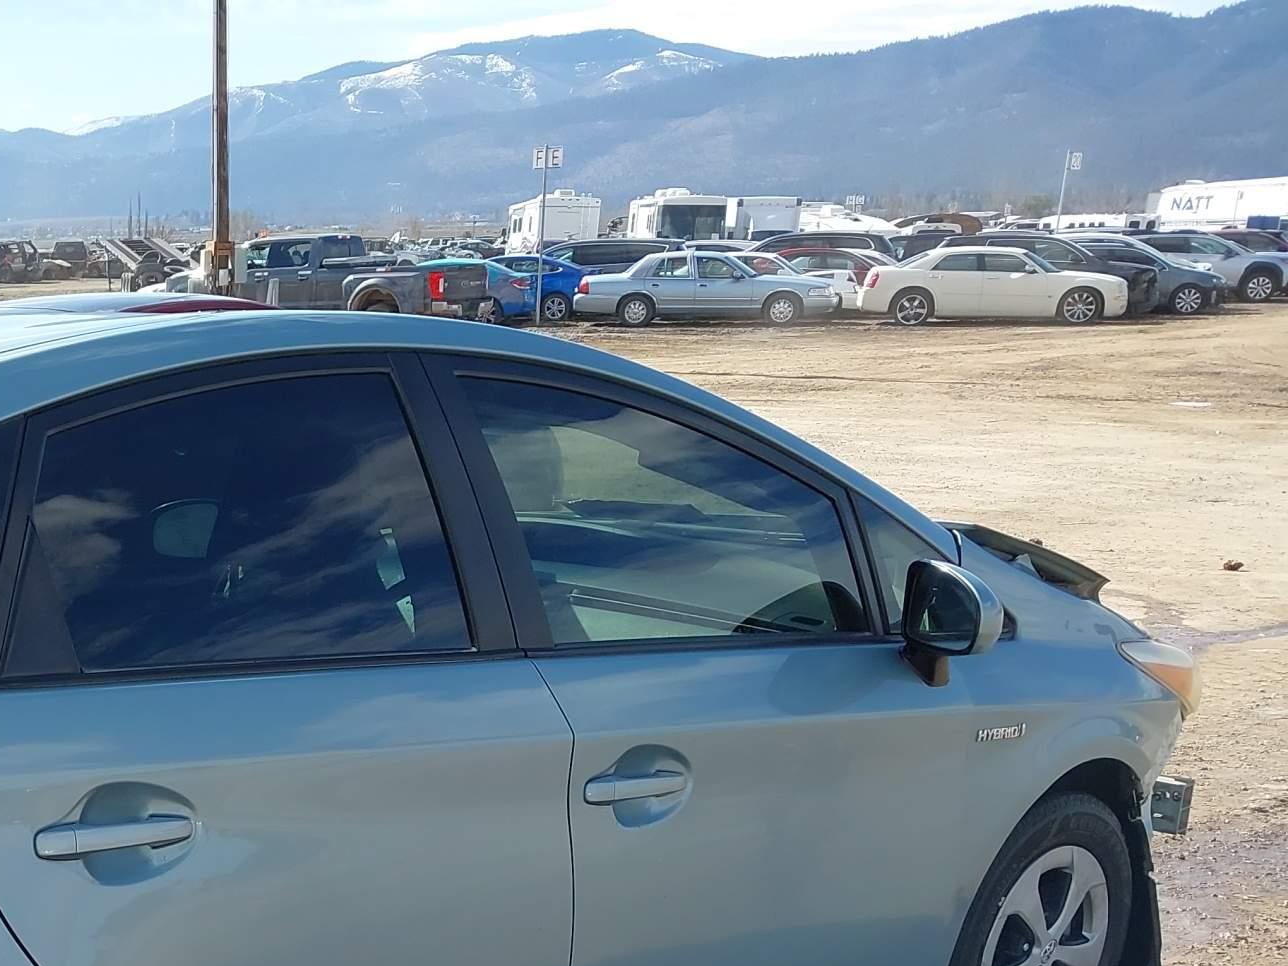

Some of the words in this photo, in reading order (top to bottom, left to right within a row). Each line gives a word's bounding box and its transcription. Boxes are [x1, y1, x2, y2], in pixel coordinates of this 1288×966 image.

[536, 150, 544, 166] F
[552, 149, 560, 166] E
[976, 726, 1020, 742] HYBRID
